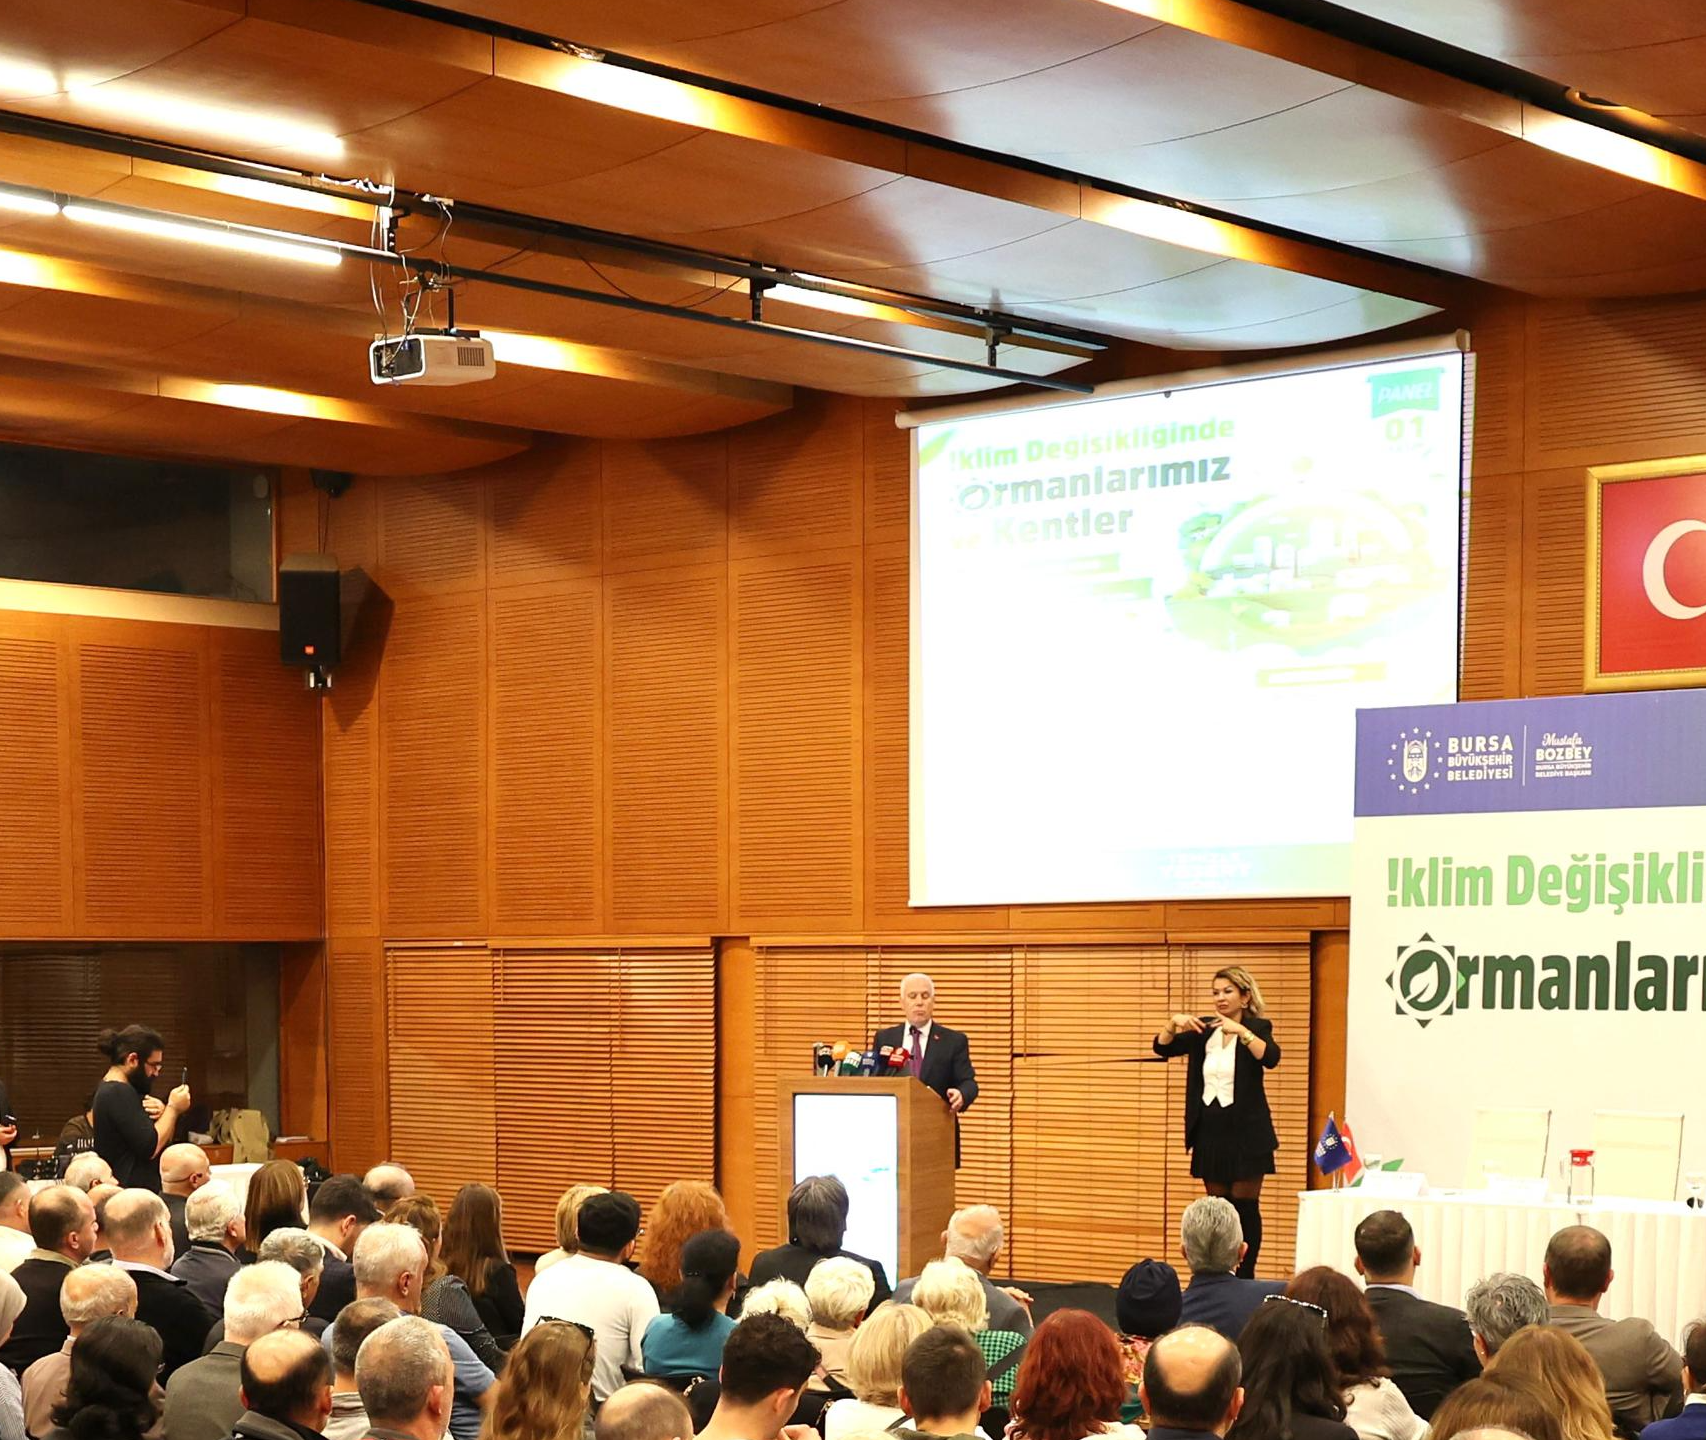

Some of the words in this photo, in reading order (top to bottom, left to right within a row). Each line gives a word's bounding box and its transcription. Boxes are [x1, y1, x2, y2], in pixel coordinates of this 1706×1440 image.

[1378, 380, 1434, 404] PANEL
[994, 508, 1134, 546] Kentler
[1448, 735, 1513, 754] BURSA
[1542, 732, 1583, 748] Mustafa
[1448, 752, 1513, 767] BÜYÜKŞEHİR
[1536, 746, 1592, 761] BOZBEY
[1447, 765, 1513, 781] BELEDİYESİ
[1386, 855, 1494, 908] !klim
